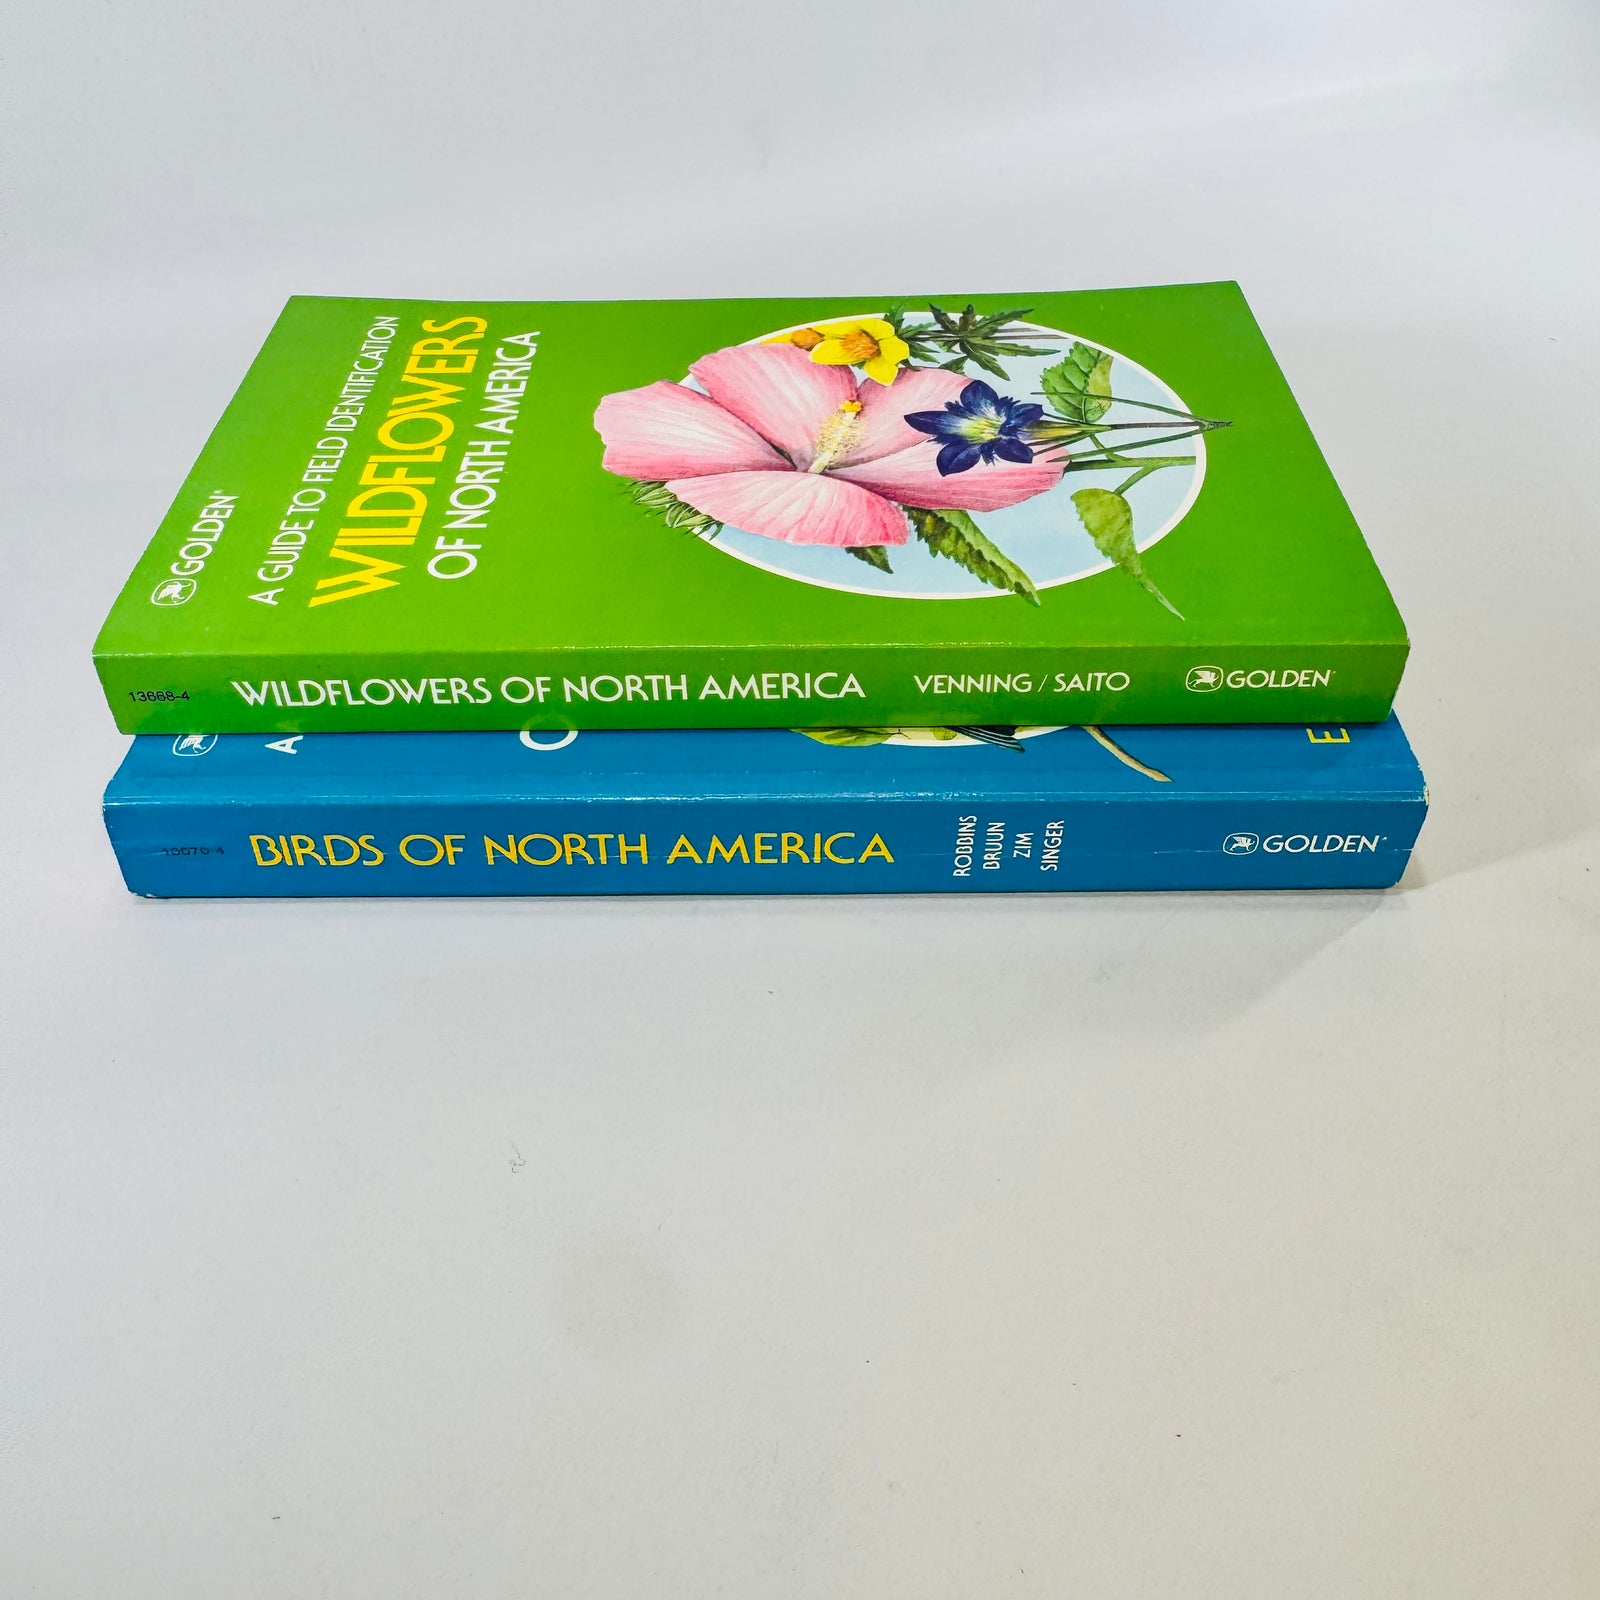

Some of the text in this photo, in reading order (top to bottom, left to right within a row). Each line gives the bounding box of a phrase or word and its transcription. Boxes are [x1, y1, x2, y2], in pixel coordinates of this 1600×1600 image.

[248, 316, 399, 605] A GUIDE TO FIELD IDENTIFICATION
[308, 316, 488, 608] WILDFLOWERS
[427, 330, 541, 580] OF NORTH AMERICA
[170, 495, 239, 576] GOLDEN
[231, 672, 866, 706] WILDFLOWERS OF NORTH AMERICA
[913, 673, 1032, 694] VENNING
[1053, 671, 1131, 692] SAITO
[1226, 670, 1331, 688] GOLDEN
[264, 735, 304, 755] A
[1306, 728, 1351, 744] E
[249, 832, 895, 866] BIRDS OF NORTH AMERICA
[954, 814, 977, 877] ROBBINS
[982, 821, 1005, 870] BRUUN
[1013, 831, 1034, 858] ZIM
[1040, 819, 1065, 871] SINGER
[1263, 834, 1380, 854] GOLDEN
